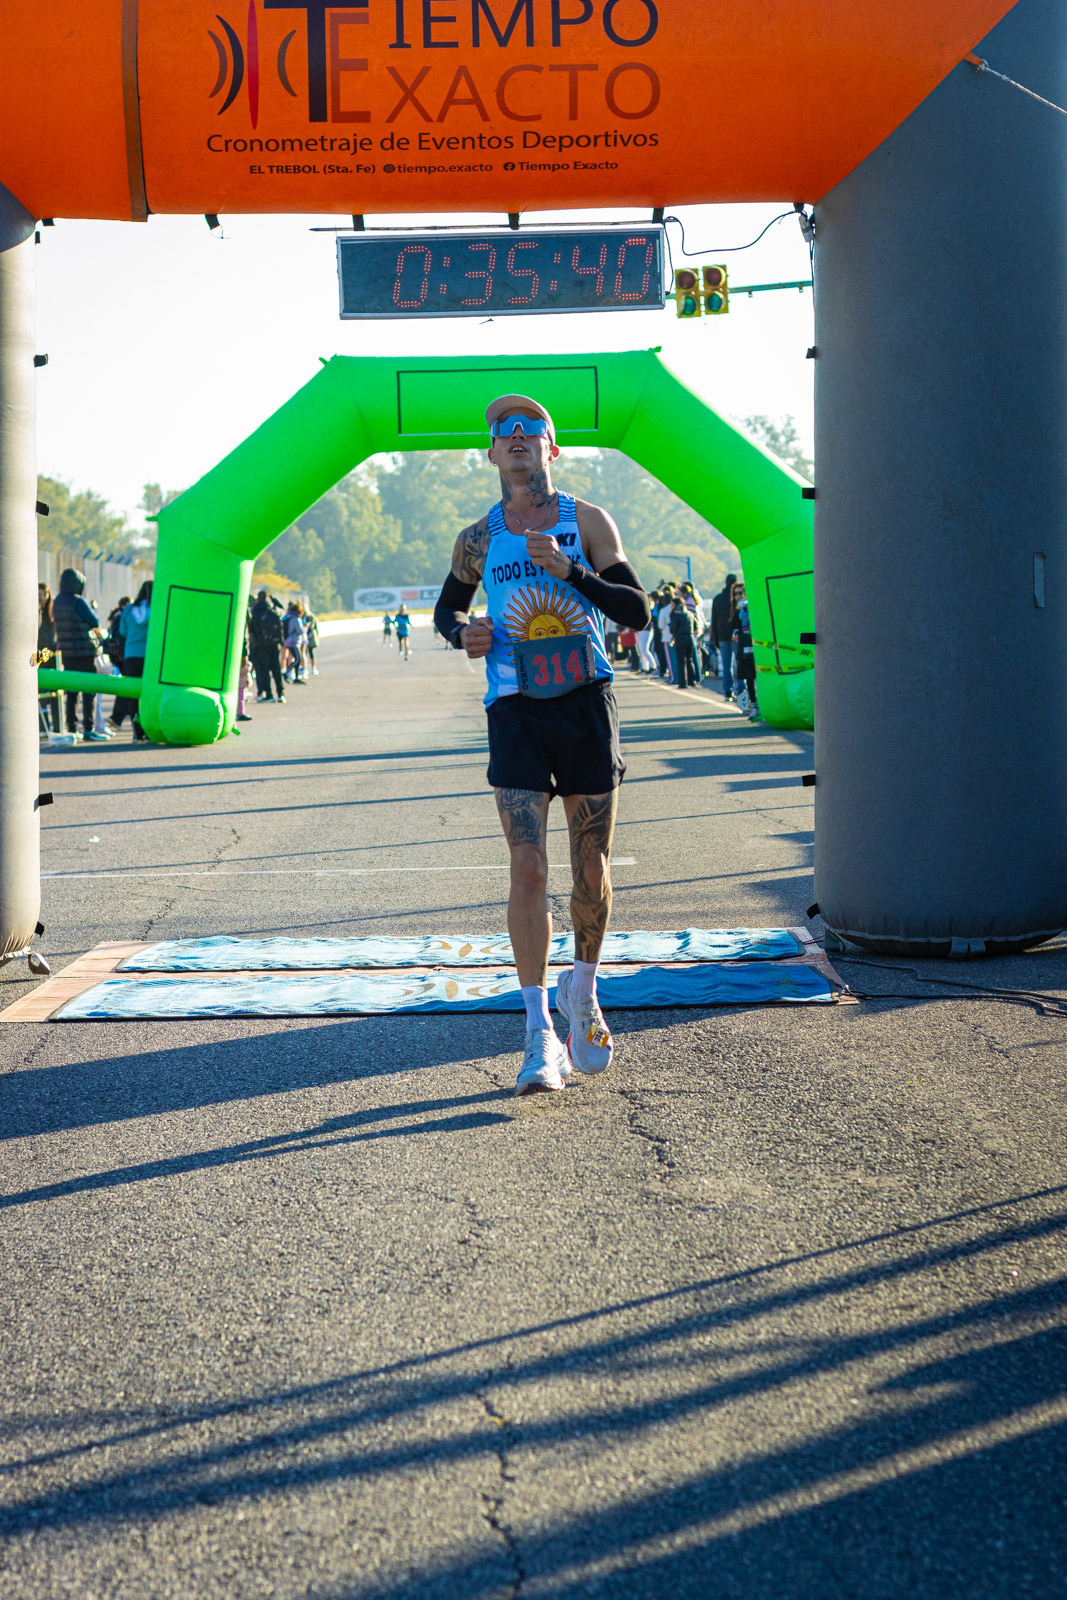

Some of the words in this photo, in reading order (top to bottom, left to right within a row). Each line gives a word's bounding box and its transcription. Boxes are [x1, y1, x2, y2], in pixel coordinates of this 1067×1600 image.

[206, 133, 373, 156] Cronometraje
[379, 132, 410, 151] de
[418, 132, 514, 151] Eventos
[522, 130, 659, 152] Deportivos
[249, 165, 265, 174] EL
[267, 164, 320, 174] TREBOL
[323, 164, 353, 175] (Sta.
[356, 163, 376, 175] Fe)
[397, 162, 493, 175] tiempo.exacto
[518, 161, 570, 172] Tiempo
[573, 160, 618, 170] Exacto
[392, 238, 653, 308] 0:35:40
[491, 561, 521, 585] TODO
[524, 560, 537, 577] ES
[532, 650, 584, 687] 314
